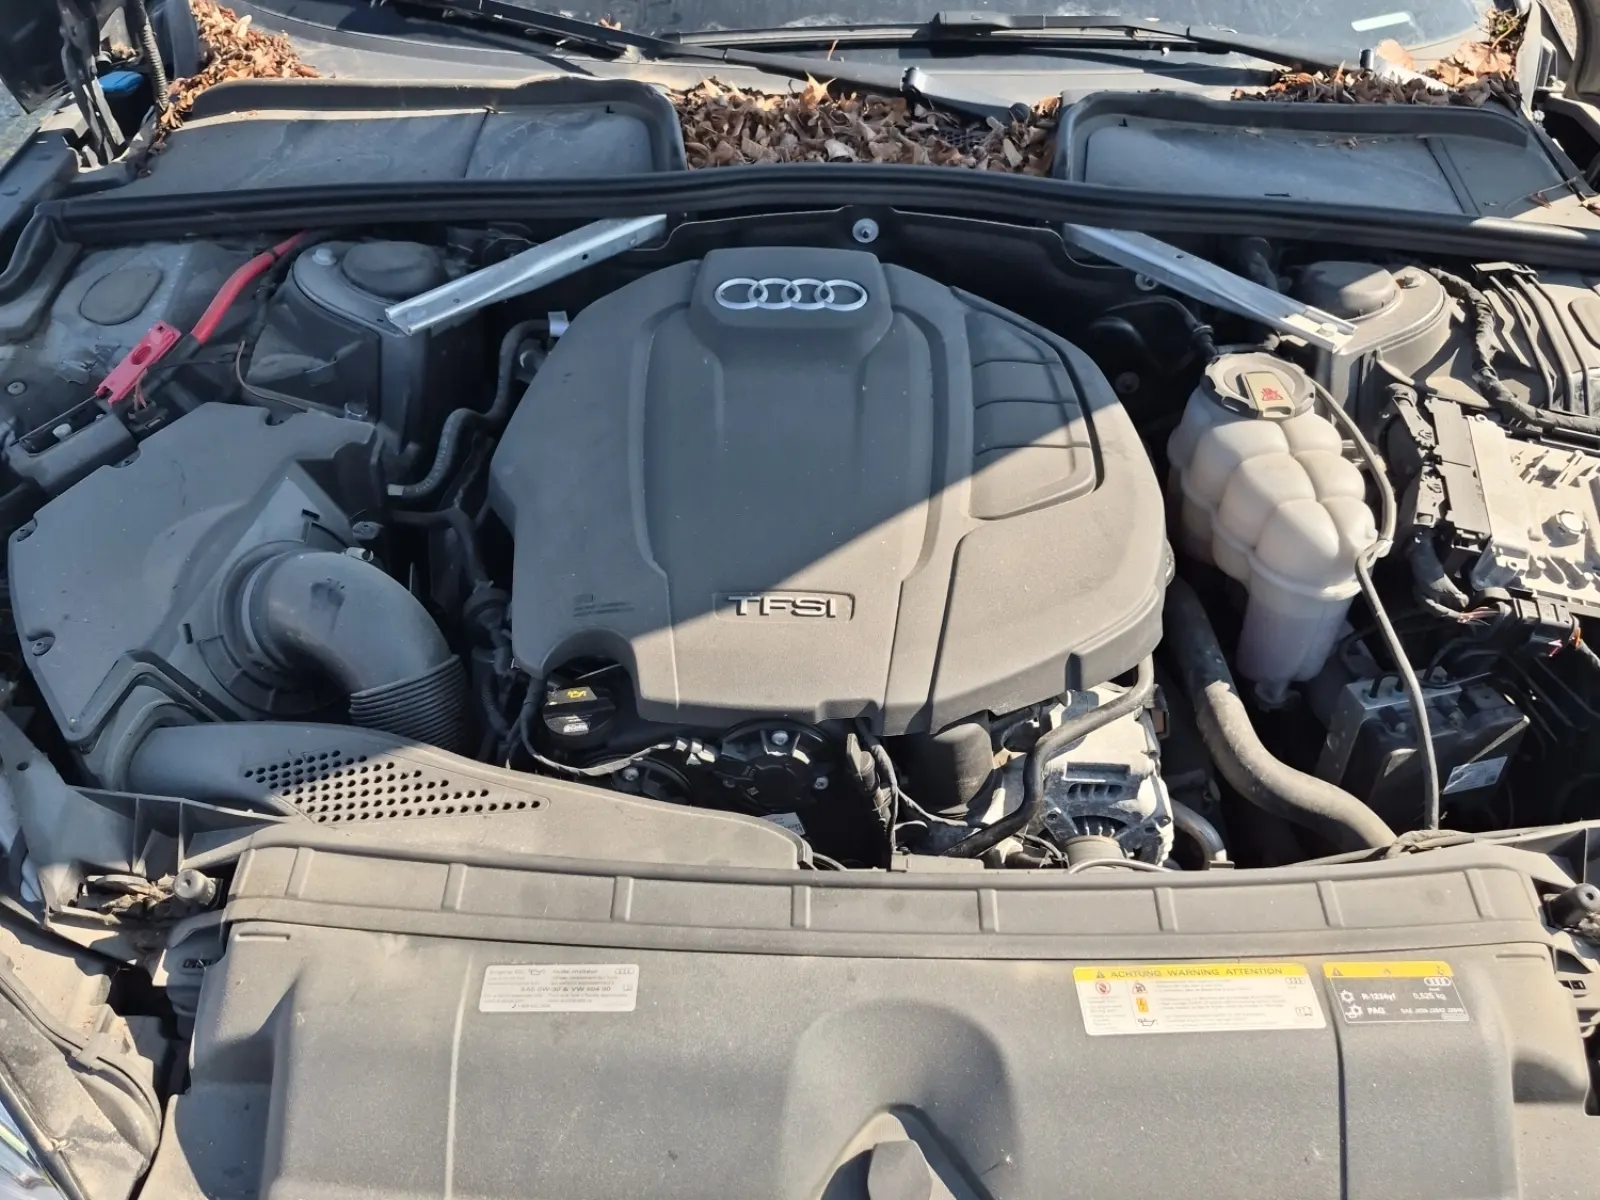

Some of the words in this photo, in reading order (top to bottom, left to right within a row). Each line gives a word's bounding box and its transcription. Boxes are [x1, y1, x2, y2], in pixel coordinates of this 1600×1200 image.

[727, 596, 836, 618] TFSI
[1110, 969, 1161, 978] ACHTUNG
[1166, 968, 1220, 977] WARNING
[1225, 967, 1283, 976] ATTENTION
[1436, 992, 1447, 1002] kg
[1366, 1007, 1387, 1015] PAG
